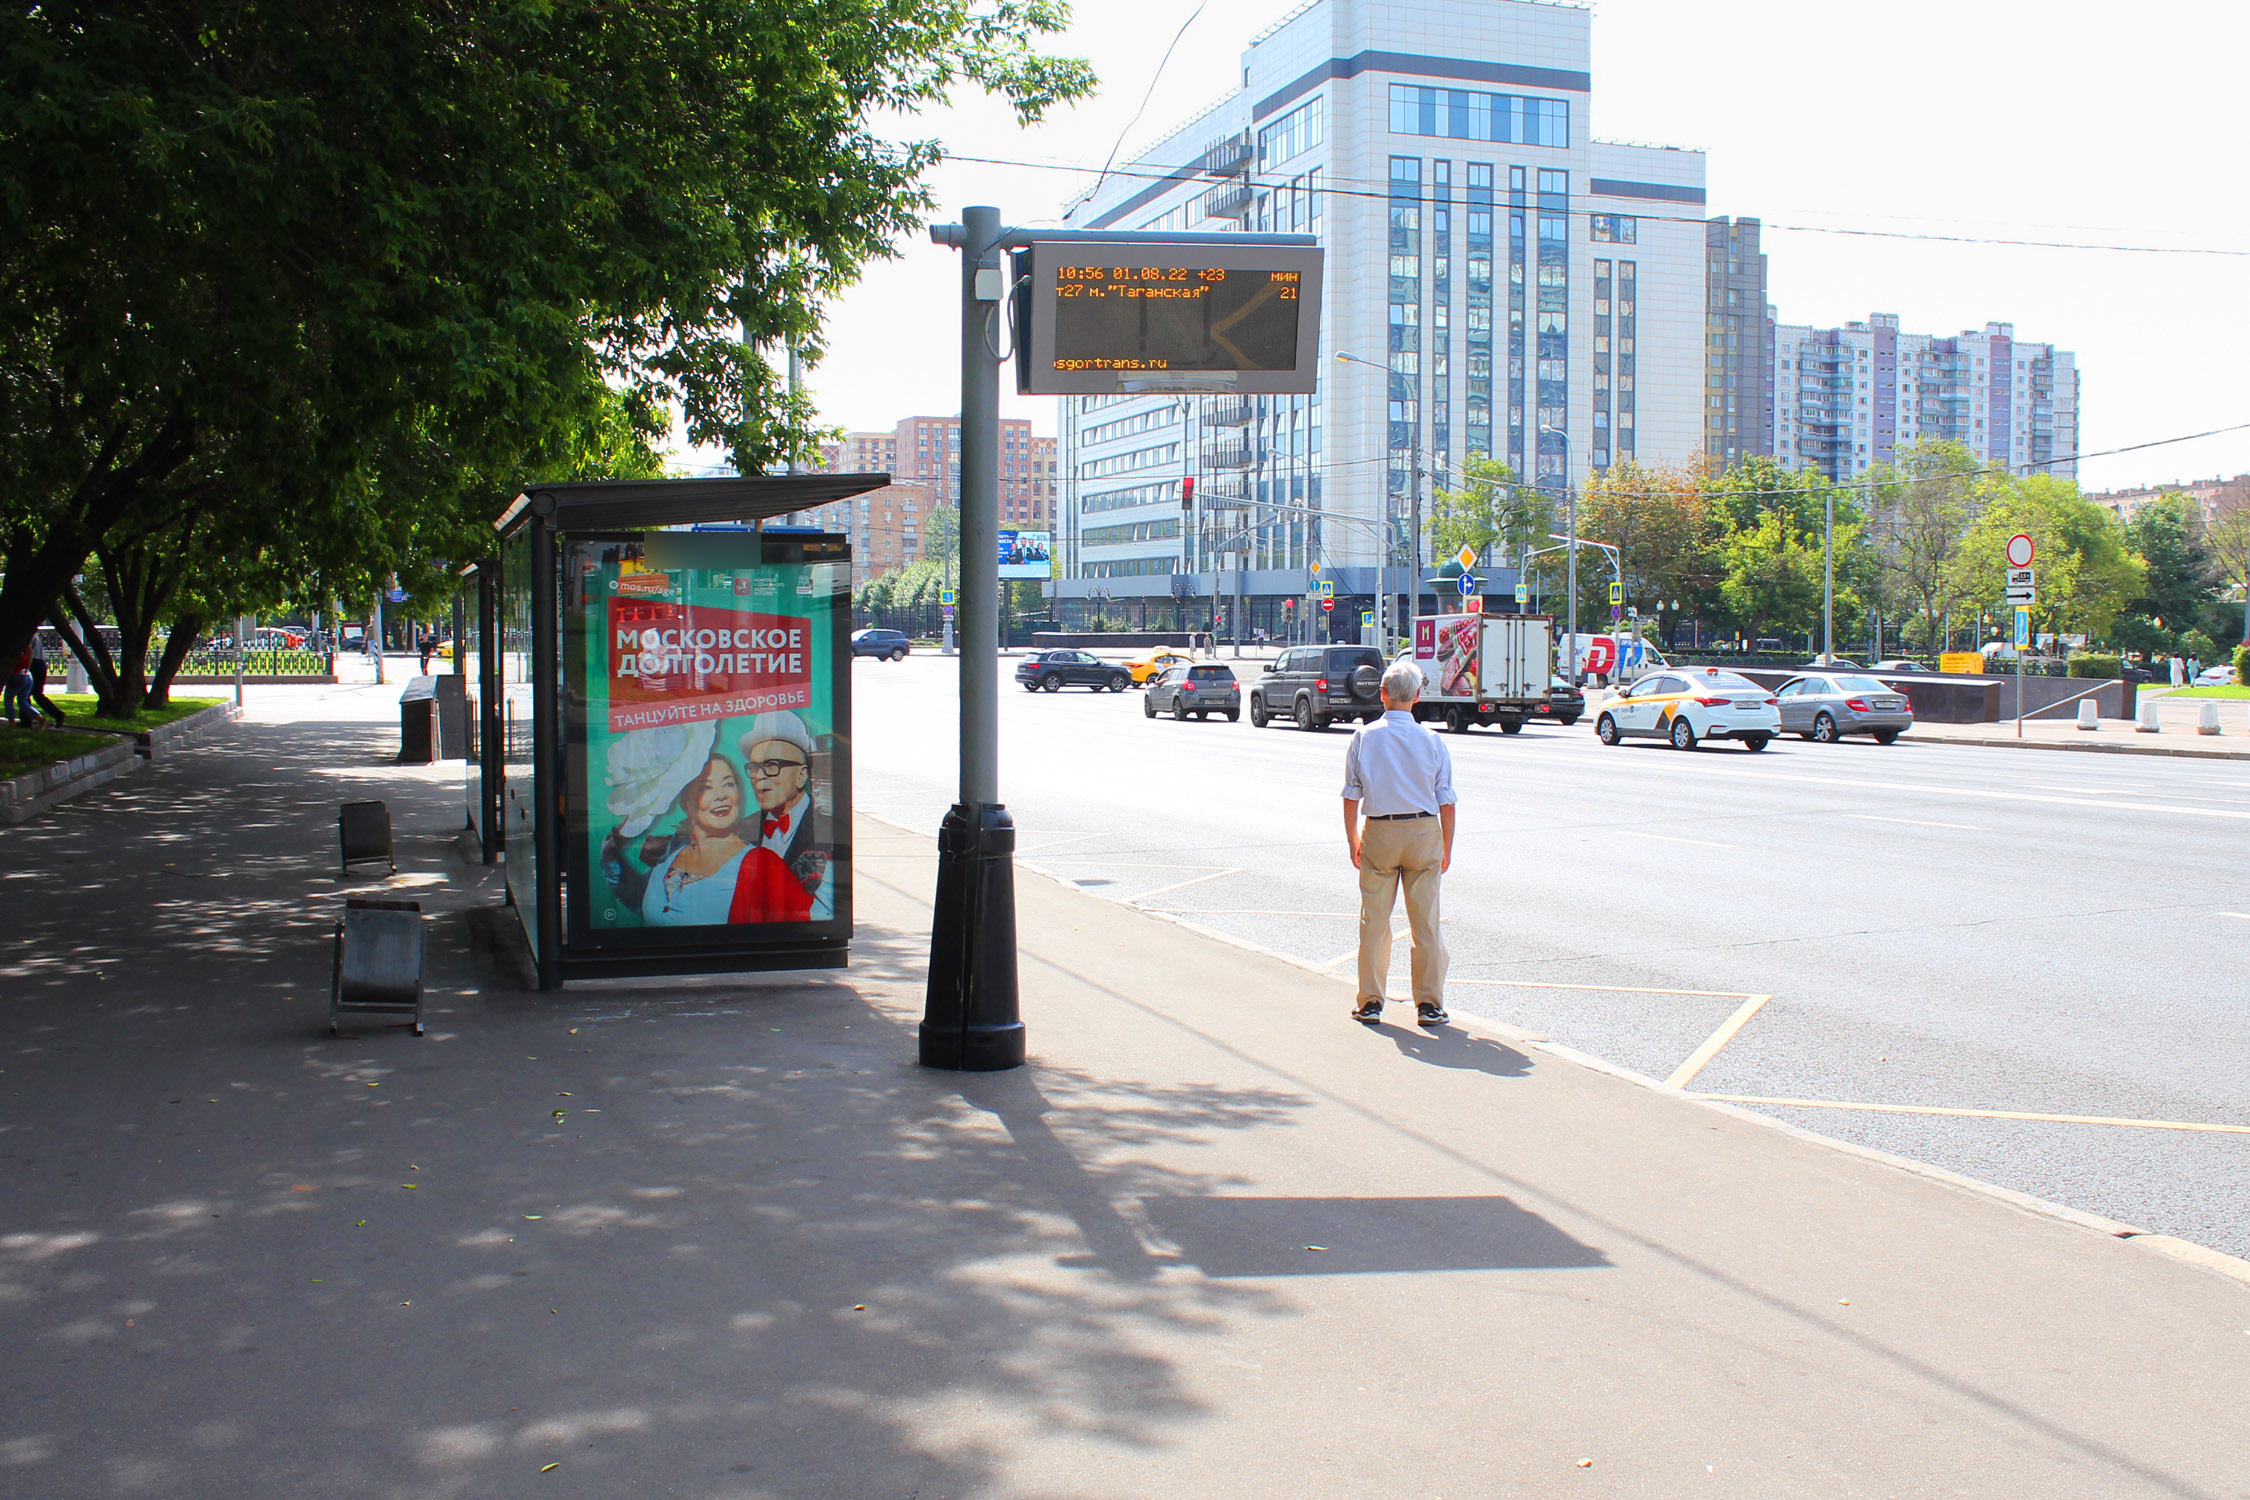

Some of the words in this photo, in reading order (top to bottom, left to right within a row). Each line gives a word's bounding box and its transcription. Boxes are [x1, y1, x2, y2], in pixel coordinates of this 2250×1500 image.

[1058, 266, 1104, 280] 10:56
[1113, 267, 1188, 281] 01.08.22
[1197, 268, 1226, 281] +23
[1089, 287, 1105, 297] м.
[1280, 286, 1297, 299] 21
[620, 582, 676, 597] mos.ru/age
[616, 628, 802, 650] МОСКОВСКОЕ
[616, 653, 803, 678] ДОЛГОЛЕТИЕ
[615, 704, 698, 728] ТАНЦУЙТЕ
[701, 700, 723, 716] НА
[725, 690, 806, 713] ЗДОРОВЬЕ
